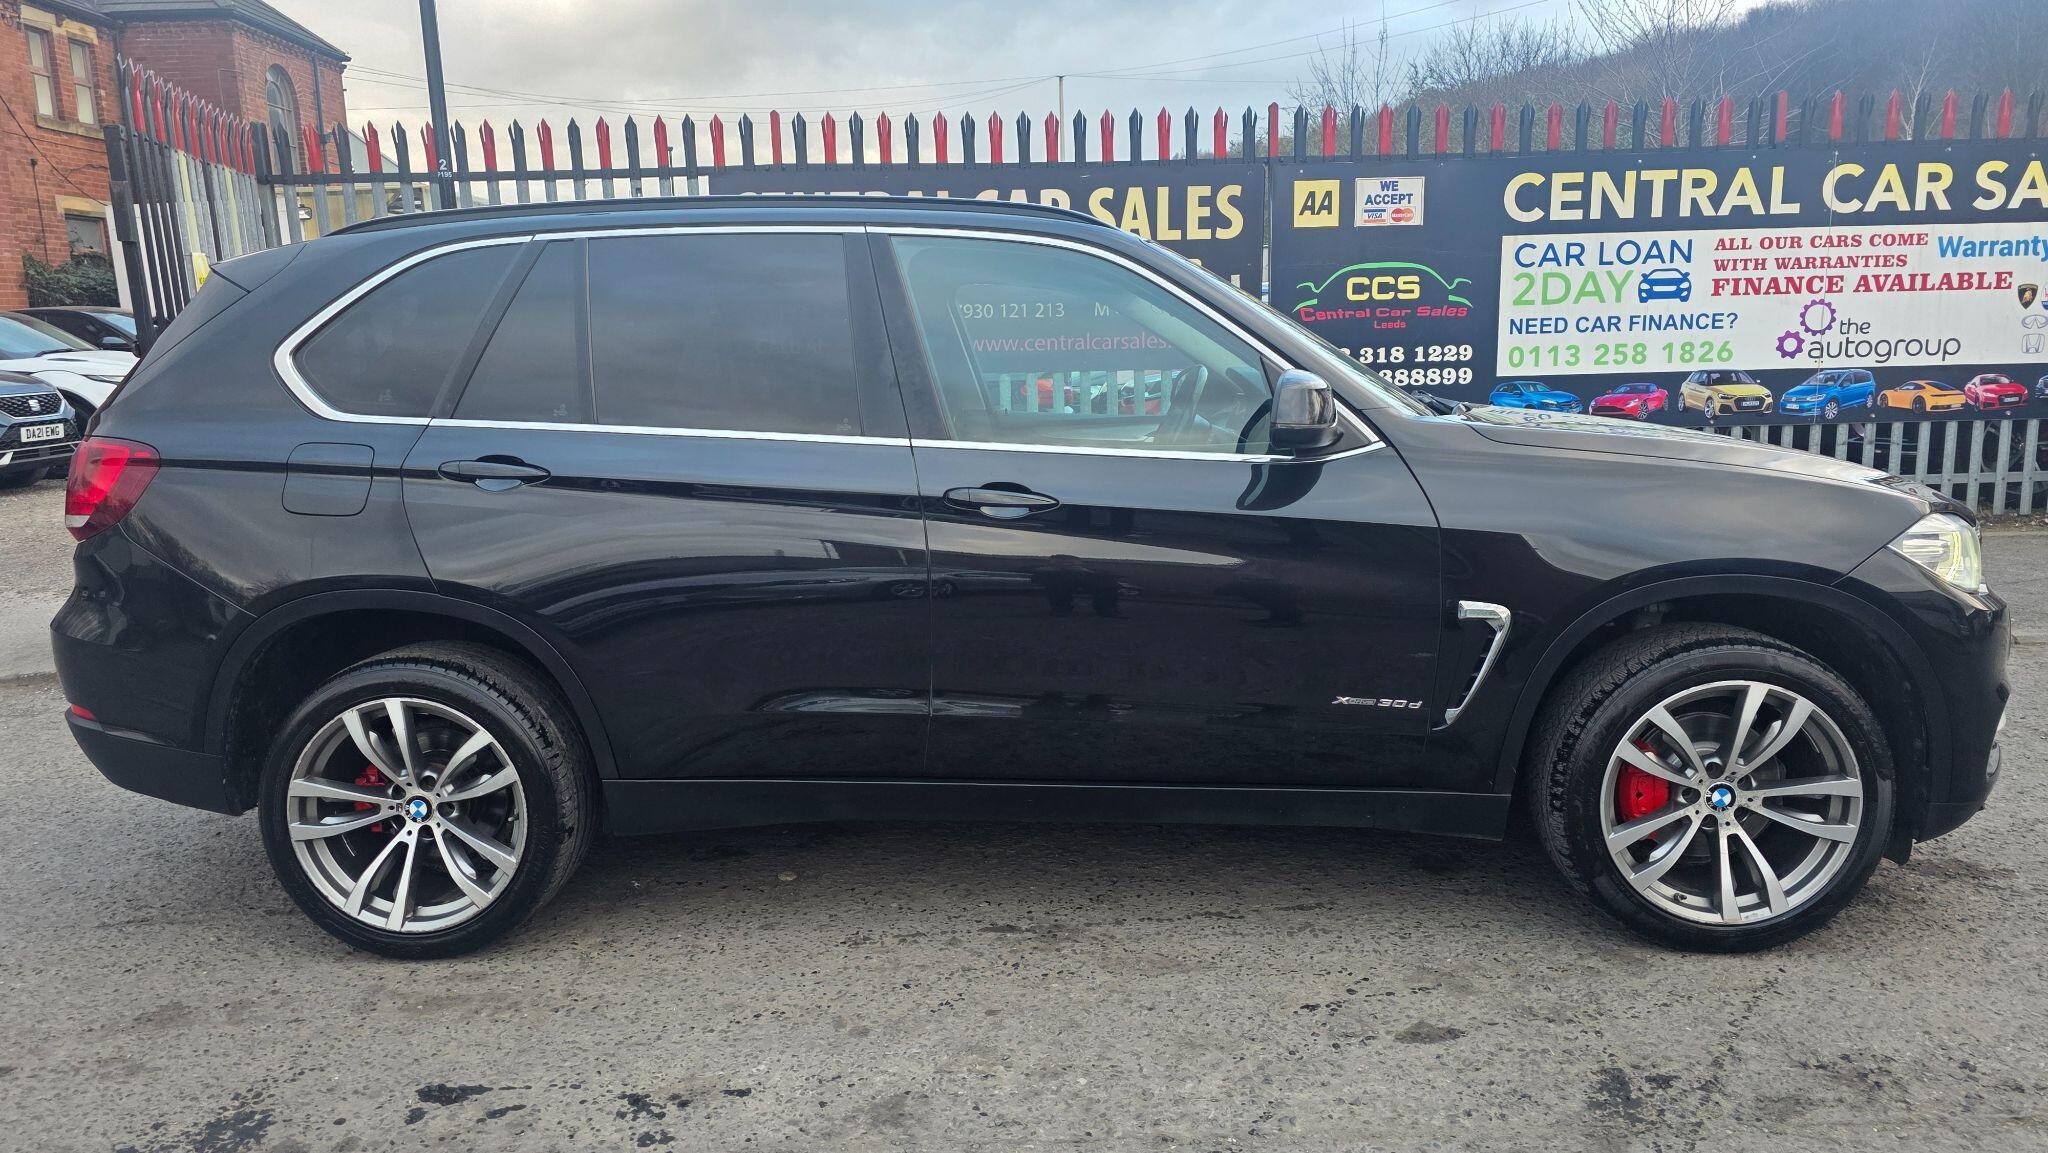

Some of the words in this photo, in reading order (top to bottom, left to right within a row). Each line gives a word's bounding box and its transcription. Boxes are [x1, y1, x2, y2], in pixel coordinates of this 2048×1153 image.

[438, 159, 448, 171] 2
[1380, 181, 1399, 192] WE
[1503, 166, 1801, 223] CENTRAL
[1822, 162, 1952, 214] CAR
[1299, 190, 1333, 216] AA
[1364, 193, 1413, 206] ACCEPT
[1088, 184, 1244, 241] SALES
[1514, 242, 1586, 268] CAR
[1598, 239, 1692, 266] LOAN
[1714, 238, 1752, 251] ALL
[1759, 236, 1803, 250] OUR
[1810, 234, 1863, 248] CARS
[1869, 233, 1929, 247] COME
[1937, 235, 2048, 262] Warranty
[1713, 258, 1768, 271] WITH
[1775, 254, 1908, 270] WARRANTIES
[1346, 275, 1421, 301] CCS
[1512, 270, 1634, 306] 2DAY
[1711, 275, 1845, 296] FINANCE
[1853, 271, 2013, 293] AVAILABLE
[958, 303, 994, 319] 930
[1000, 302, 1027, 318] 121
[1035, 302, 1065, 318] 213
[1300, 307, 1371, 322] Central
[1375, 307, 1412, 318] Car
[1416, 305, 1469, 317] Sales
[1374, 320, 1407, 329] Leeds
[1509, 317, 1569, 335] NEED
[1575, 315, 1622, 333] CAR
[1629, 312, 1739, 332] FINANCE?
[1840, 317, 1871, 335] the
[1359, 346, 1405, 364] 318
[1414, 344, 1473, 362] 1229
[1508, 344, 1581, 368] 0113
[1593, 341, 1648, 366] 258
[1662, 340, 1734, 364] 1826
[1808, 337, 1961, 364] autogroup
